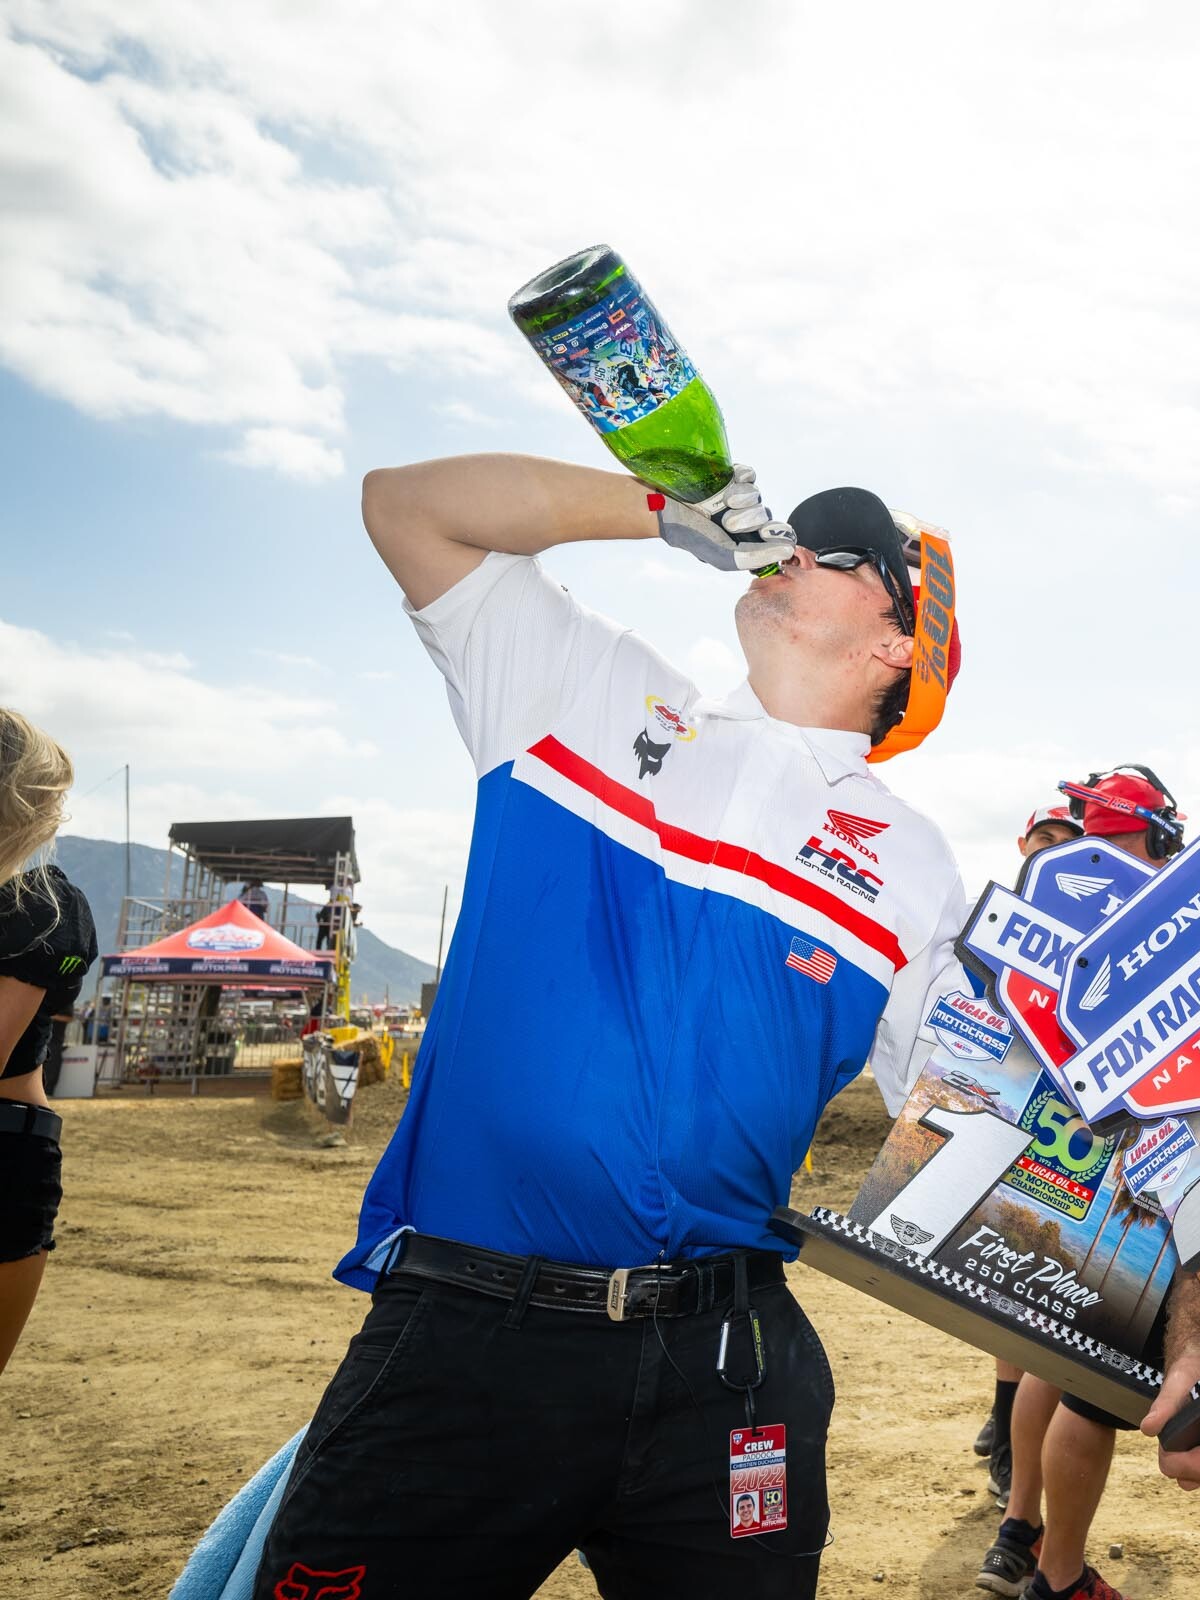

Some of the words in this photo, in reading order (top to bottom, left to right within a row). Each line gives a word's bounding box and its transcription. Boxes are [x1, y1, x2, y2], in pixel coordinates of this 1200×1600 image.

[822, 822, 879, 864] HONDA
[795, 855, 835, 880] Honda
[836, 877, 876, 904] RACING
[798, 835, 884, 897] HRC
[997, 911, 1076, 977] FOX
[934, 1008, 1007, 1051] MOTOCROSS
[951, 997, 988, 1021] LUCAS
[986, 1016, 1006, 1031] OIL
[1087, 1019, 1156, 1093] FOX
[1030, 1098, 1105, 1172] 50
[1130, 1134, 1158, 1164] LUCAS
[1158, 1122, 1174, 1140] OIL
[1028, 1162, 1056, 1182] LUCAS
[1056, 1176, 1071, 1189] OIL
[1129, 1131, 1191, 1186] MOTOCROSS
[869, 1104, 1037, 1257] 1
[1010, 1166, 1024, 1178] RO
[1026, 1173, 1086, 1209] MOTOCROSS
[1011, 1177, 1071, 1211] CHAMPIONSHIP
[957, 1224, 1036, 1273] First
[1025, 1255, 1103, 1308] Place
[965, 1257, 1005, 1284] 250
[1013, 1281, 1077, 1320] CLASS
[742, 1451, 776, 1462] PADDOCK
[744, 1440, 774, 1453] CREW
[732, 1465, 785, 1494] 2022
[765, 1490, 781, 1505] 50
